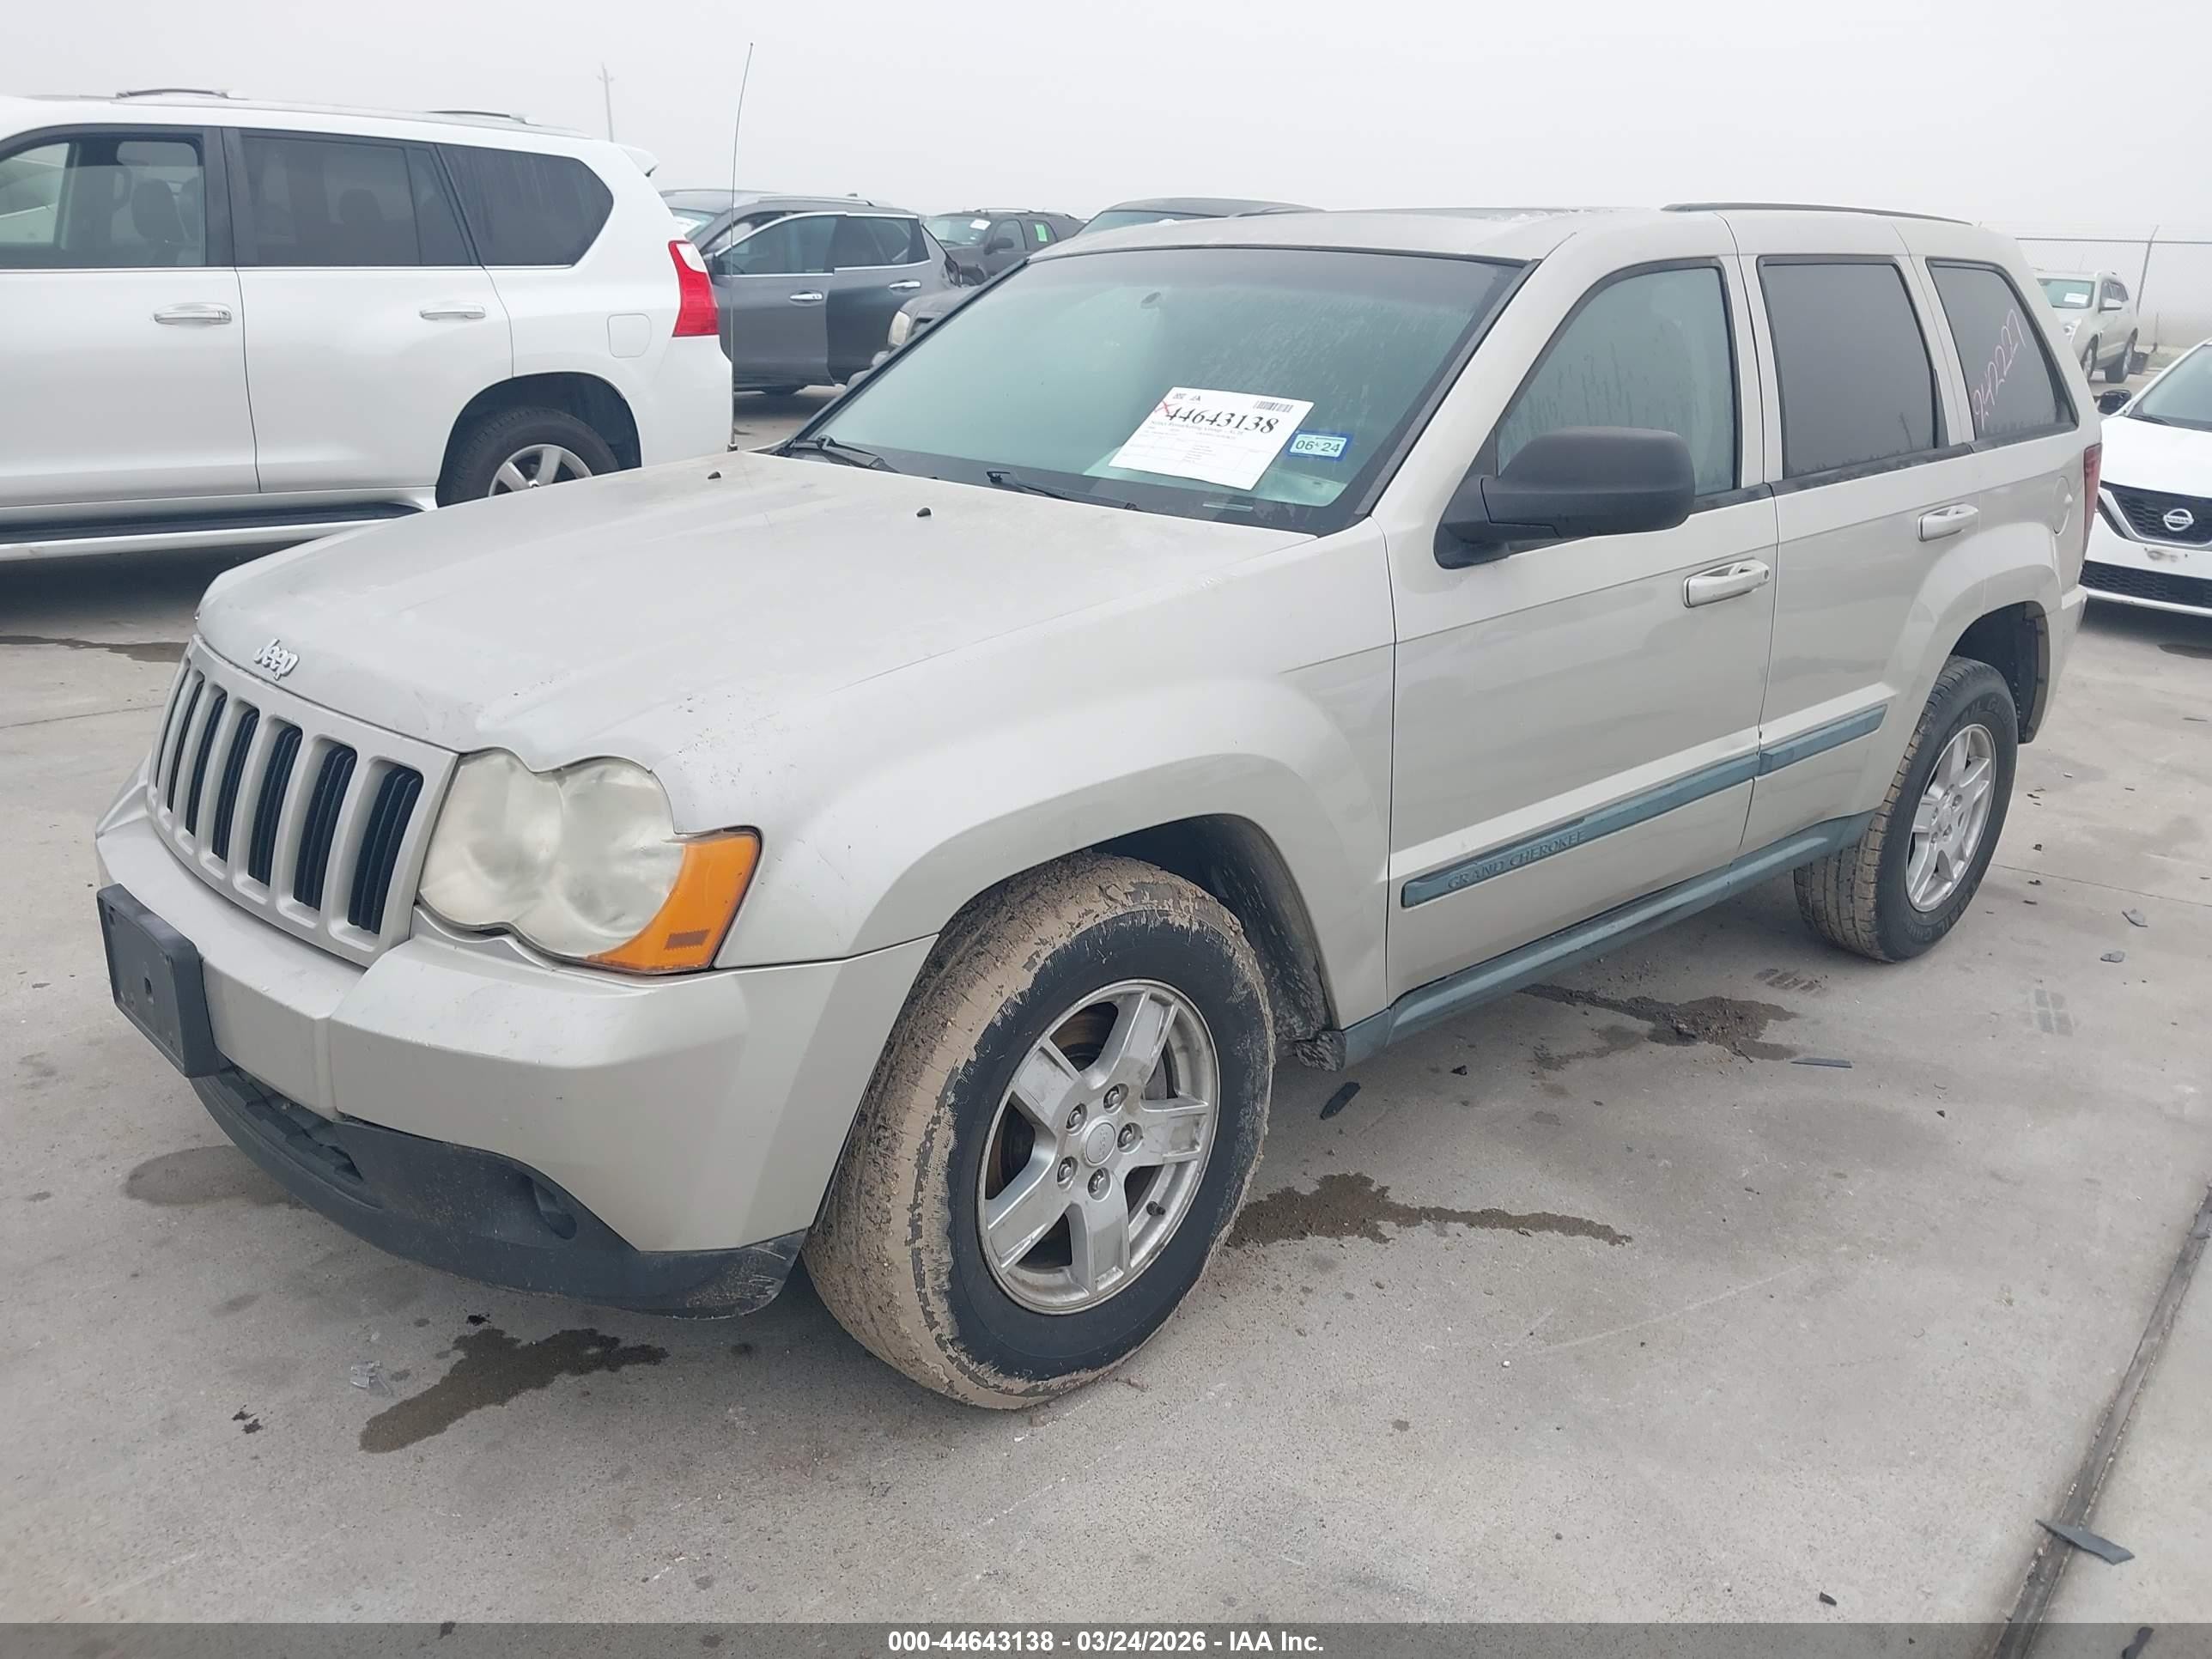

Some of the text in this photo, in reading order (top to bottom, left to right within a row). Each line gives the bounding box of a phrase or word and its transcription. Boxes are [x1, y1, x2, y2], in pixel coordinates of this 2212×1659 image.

[1165, 406, 1279, 434] 44643138
[1295, 440, 1340, 453] 06 24
[252, 638, 300, 681] Jeep
[1448, 830, 1587, 890] GRAND CHEROKEE
